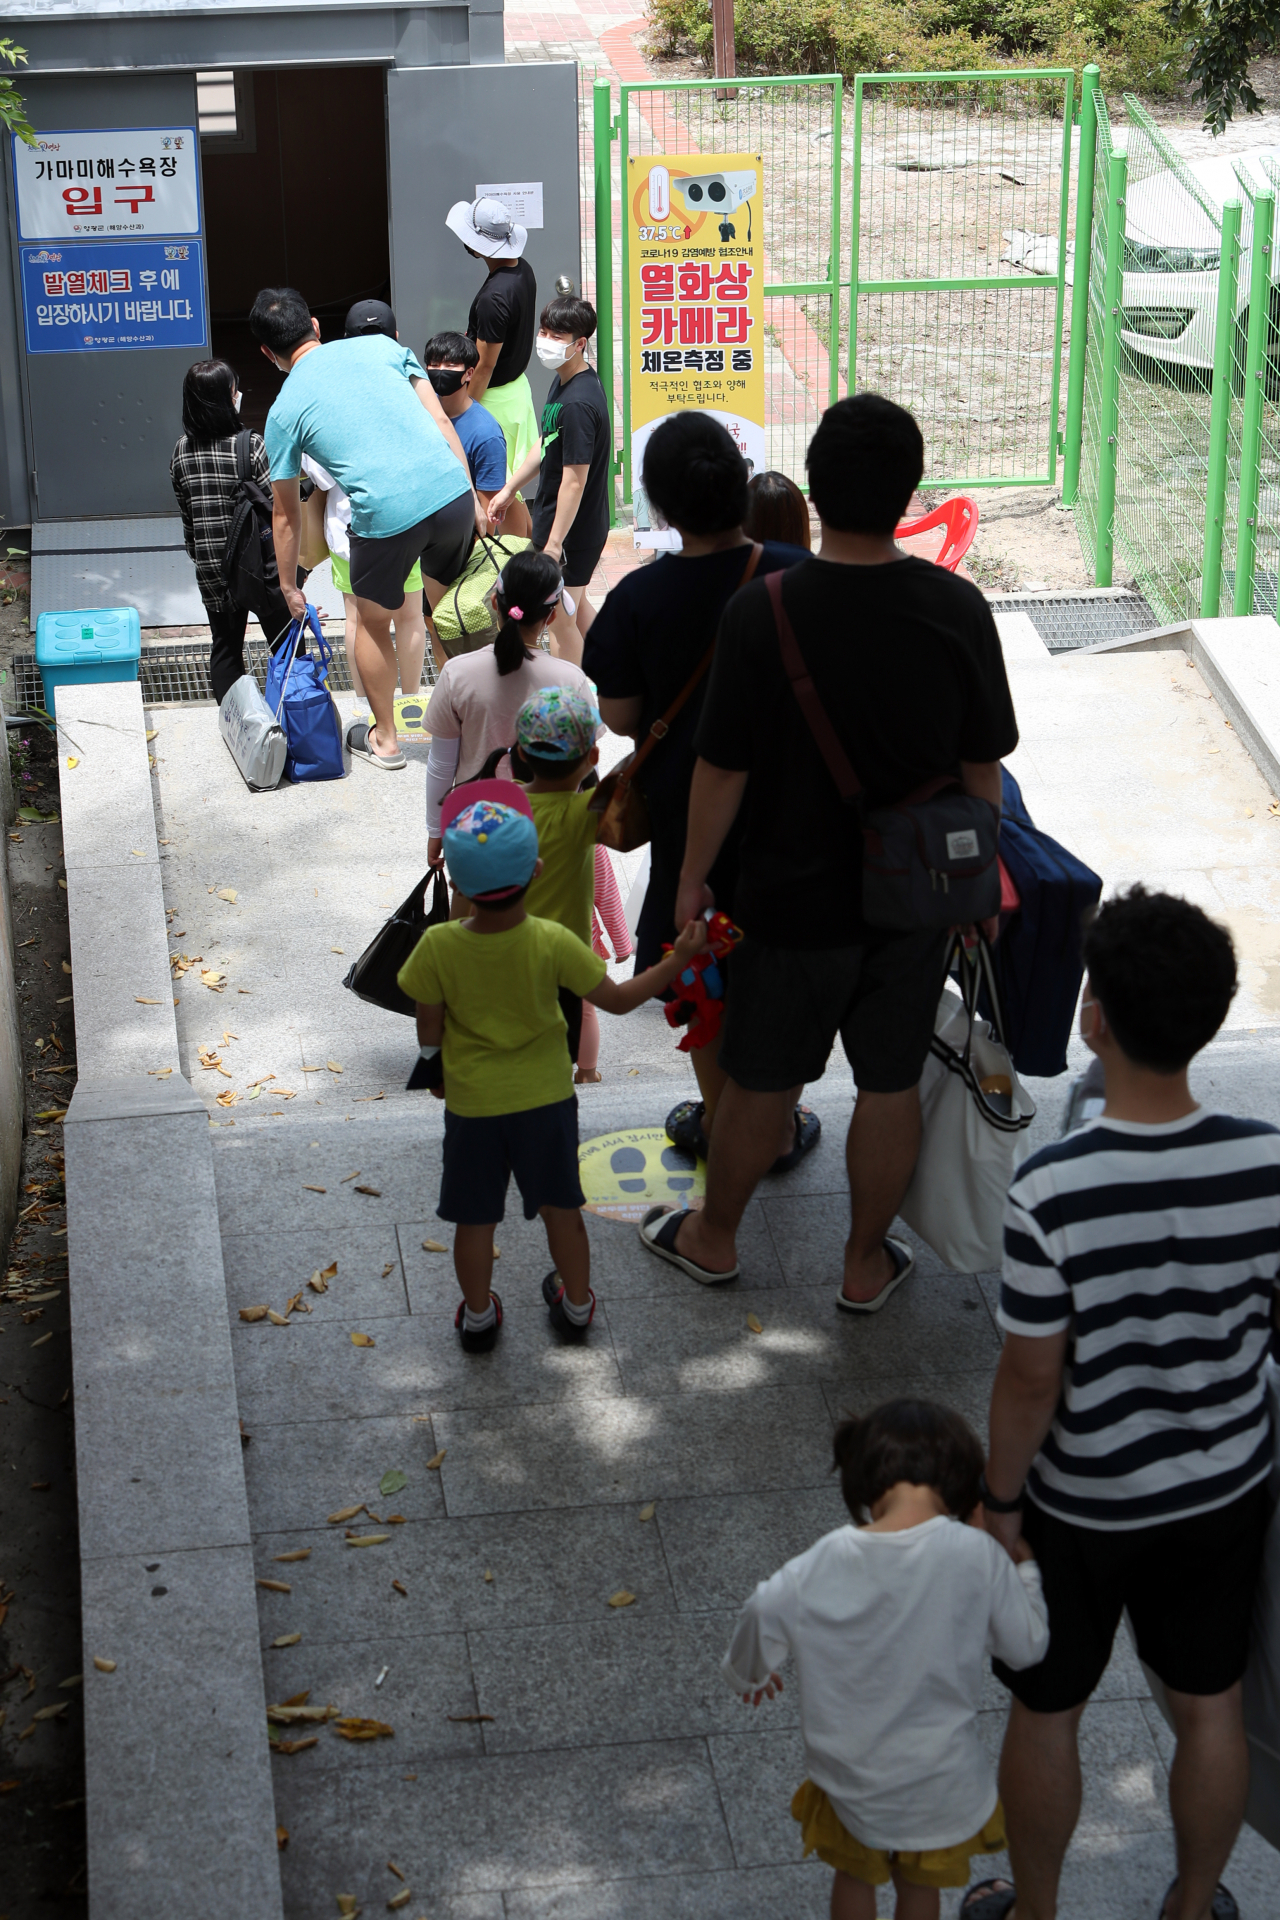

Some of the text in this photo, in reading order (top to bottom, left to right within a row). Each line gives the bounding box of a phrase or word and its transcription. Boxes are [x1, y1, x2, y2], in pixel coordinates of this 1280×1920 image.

[35, 156, 177, 180] 가마미해수욕장
[62, 185, 156, 215] 입구
[640, 247, 753, 258] 코로나19 감염예방 협조안내
[44, 268, 180, 296] 발열체크 후에
[641, 262, 753, 302] 열화상
[36, 299, 194, 325] 입장하시기 바랍니다.
[641, 306, 753, 345] 카메라
[641, 350, 752, 372] 체온측정 중
[649, 379, 746, 392] 적극적인 협조와 양해
[667, 393, 729, 404] 부탁드립니다.
